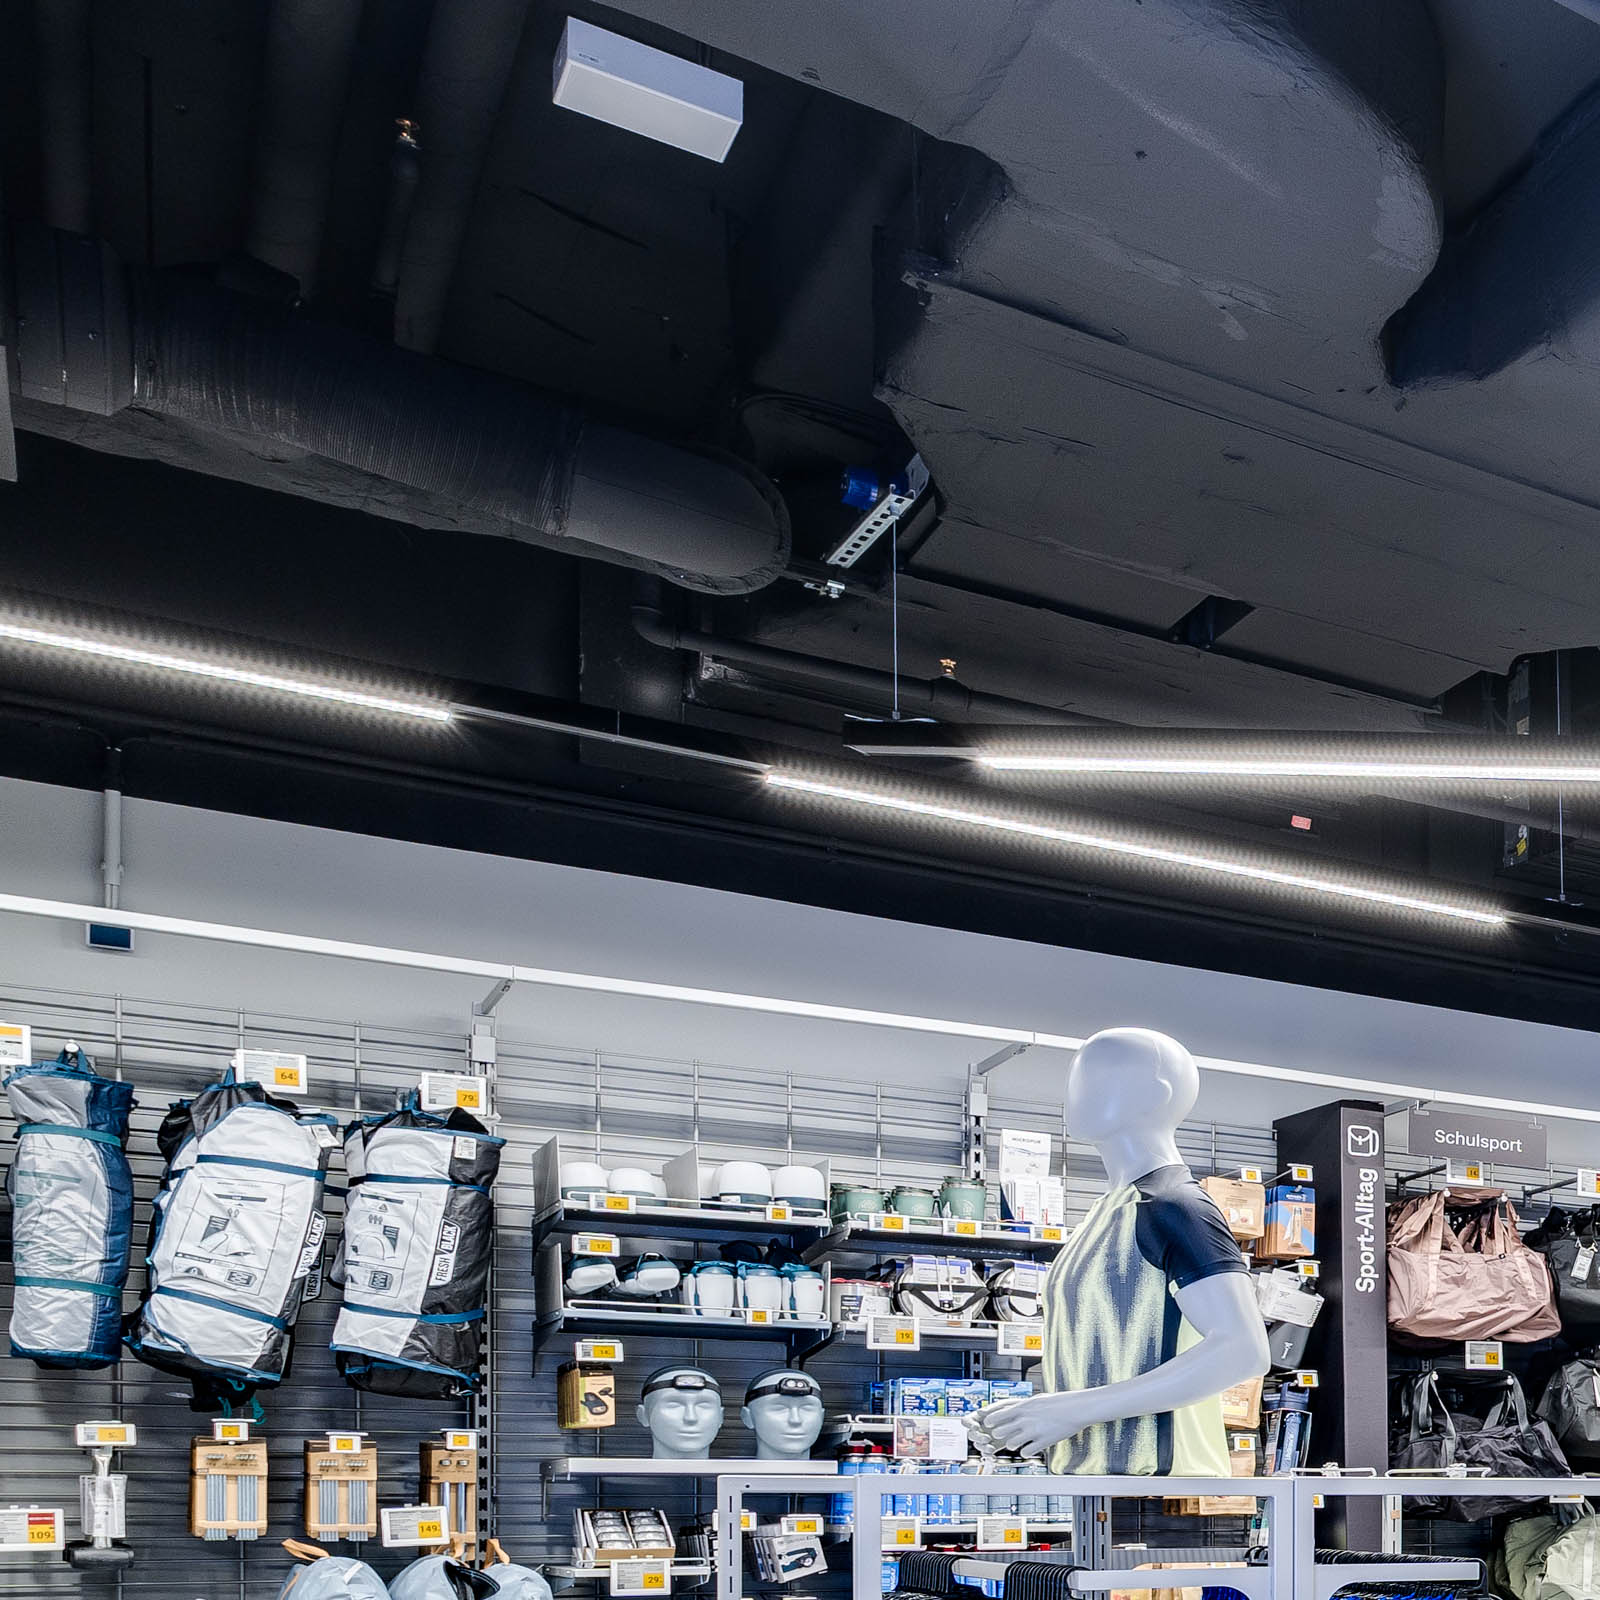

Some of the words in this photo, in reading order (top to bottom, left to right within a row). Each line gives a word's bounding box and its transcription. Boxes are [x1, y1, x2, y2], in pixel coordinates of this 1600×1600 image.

[1434, 1129, 1523, 1152] Schulsport
[309, 1217, 326, 1246] BLACK
[440, 1224, 458, 1251] BLACK
[1354, 1168, 1379, 1293] Sport-Alltag
[435, 1257, 451, 1282] FRESH
[306, 1270, 320, 1298] FRESH
